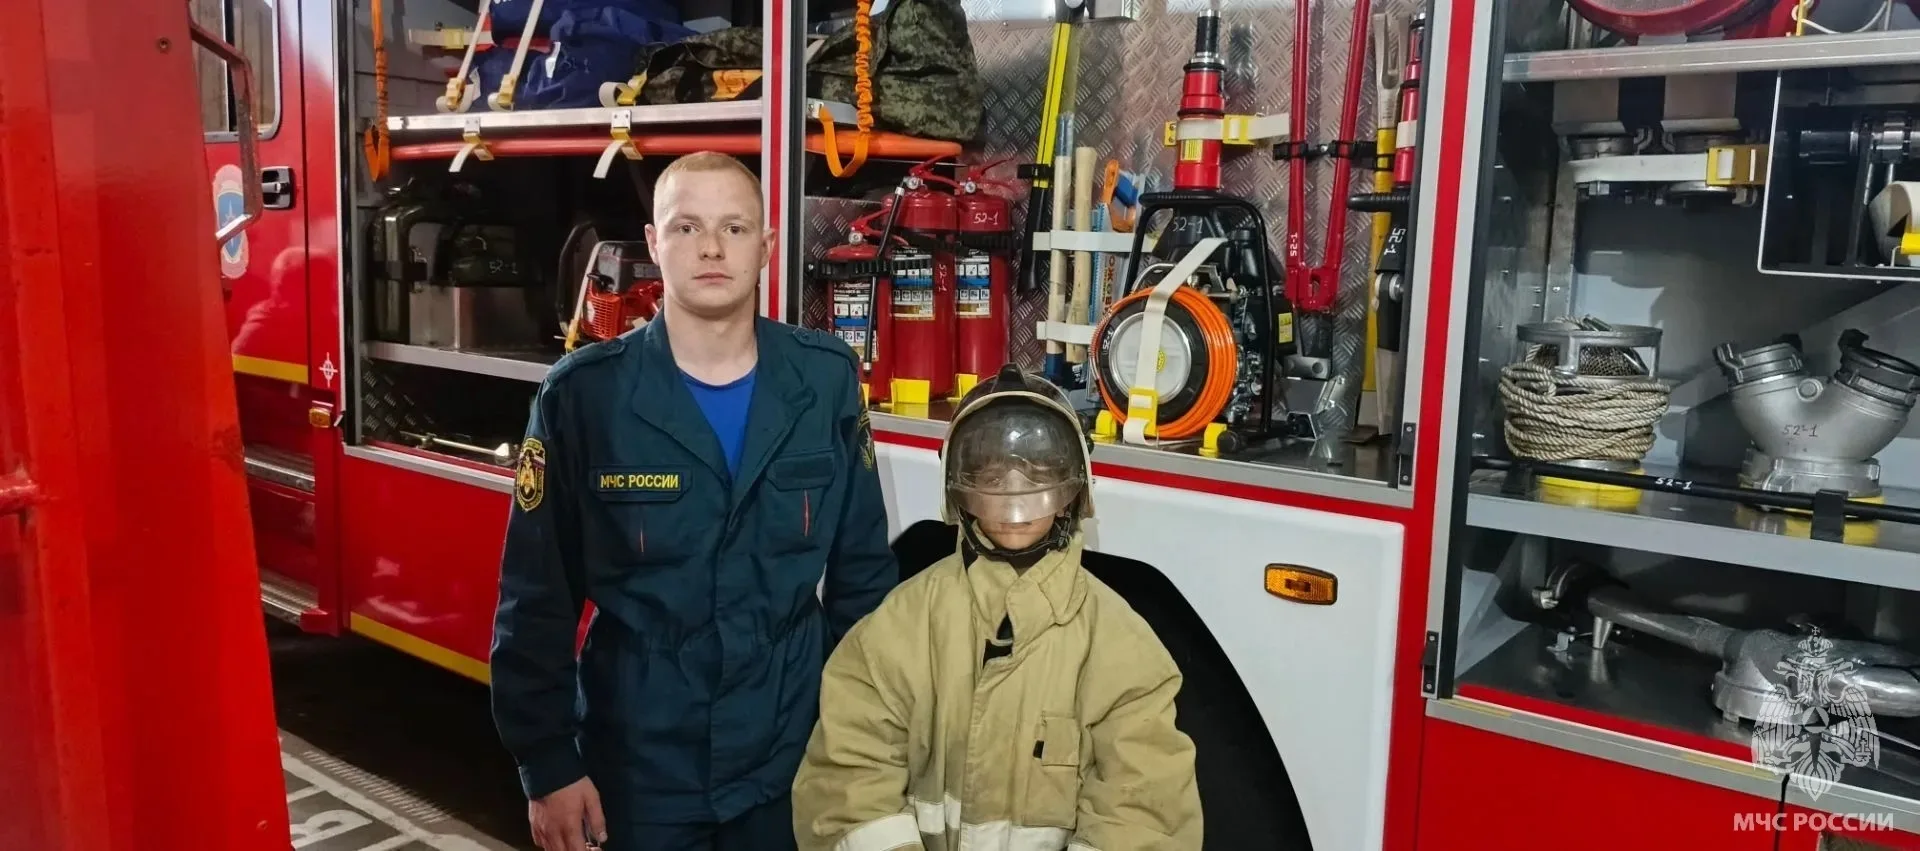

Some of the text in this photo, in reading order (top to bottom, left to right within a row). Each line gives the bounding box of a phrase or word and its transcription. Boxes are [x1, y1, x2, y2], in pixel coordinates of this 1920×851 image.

[973, 211, 999, 225] 52-1
[1172, 216, 1204, 234] 52-1
[1290, 232, 1298, 257] 52-1
[1382, 227, 1406, 256] 52-1
[938, 263, 948, 292] 52-1
[1781, 424, 1819, 438] 52-1
[600, 474, 679, 489] МЧС РОССИИ
[1654, 476, 1693, 490] 52-1
